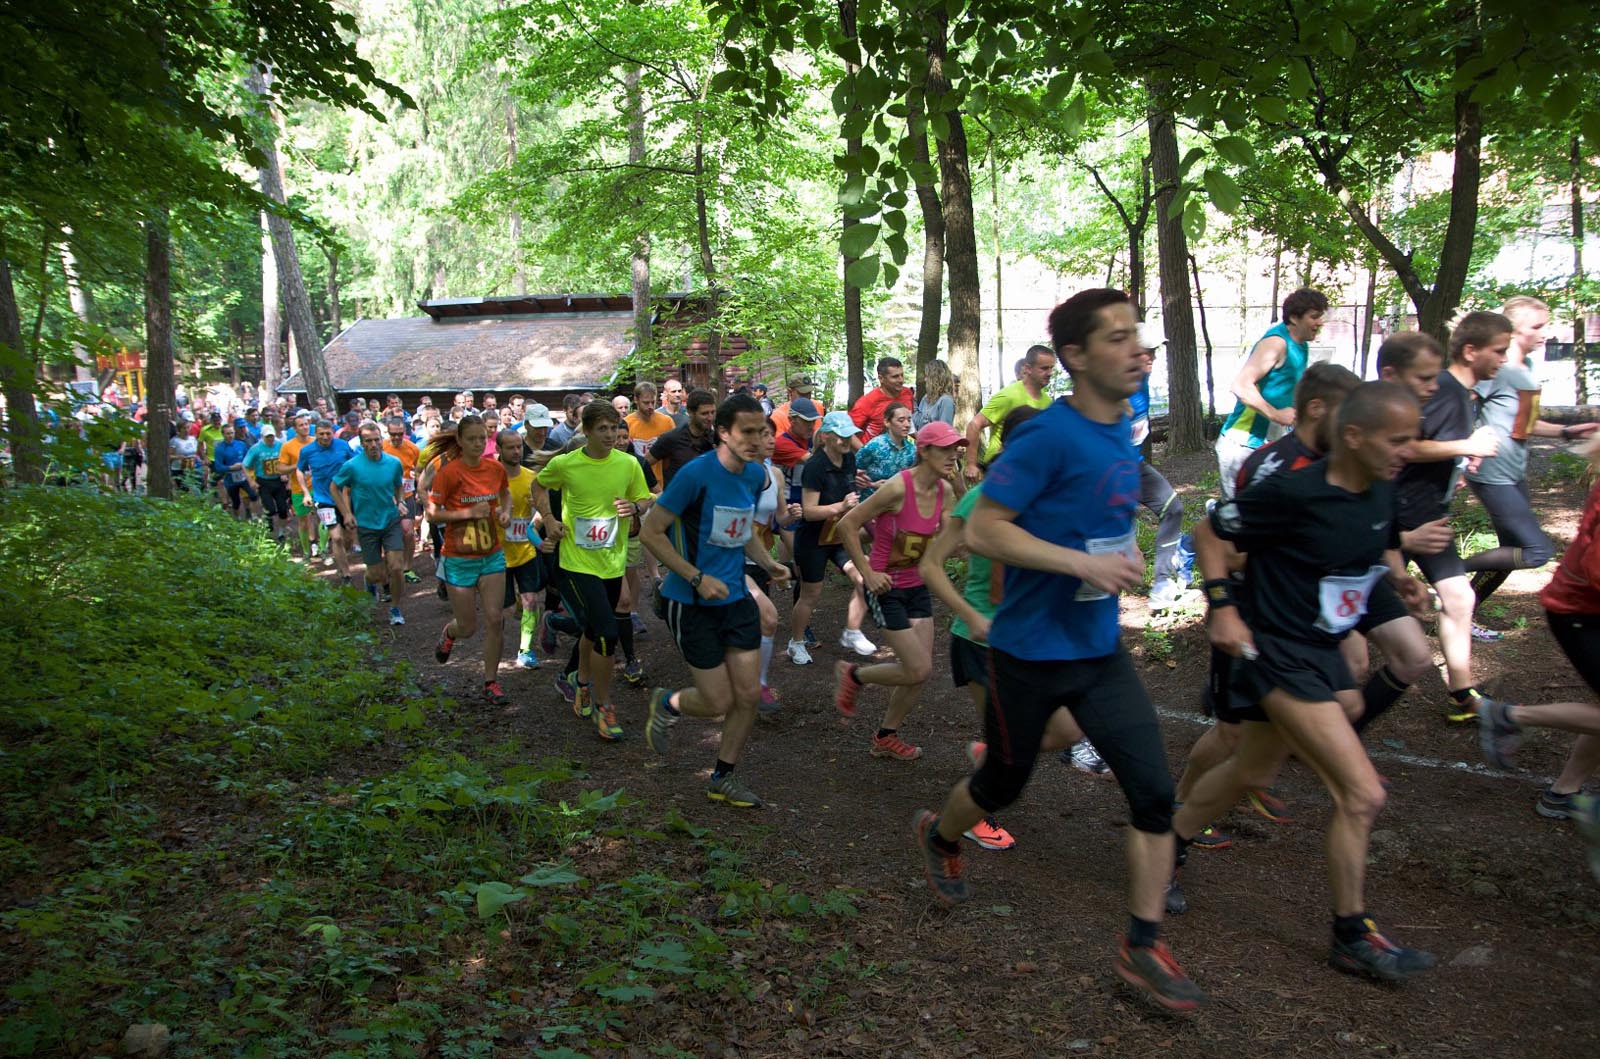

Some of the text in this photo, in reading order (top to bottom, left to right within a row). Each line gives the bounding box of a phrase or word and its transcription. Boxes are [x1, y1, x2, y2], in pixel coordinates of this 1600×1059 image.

[463, 518, 492, 552] 48
[586, 524, 608, 542] 46
[1335, 590, 1362, 618] 8
